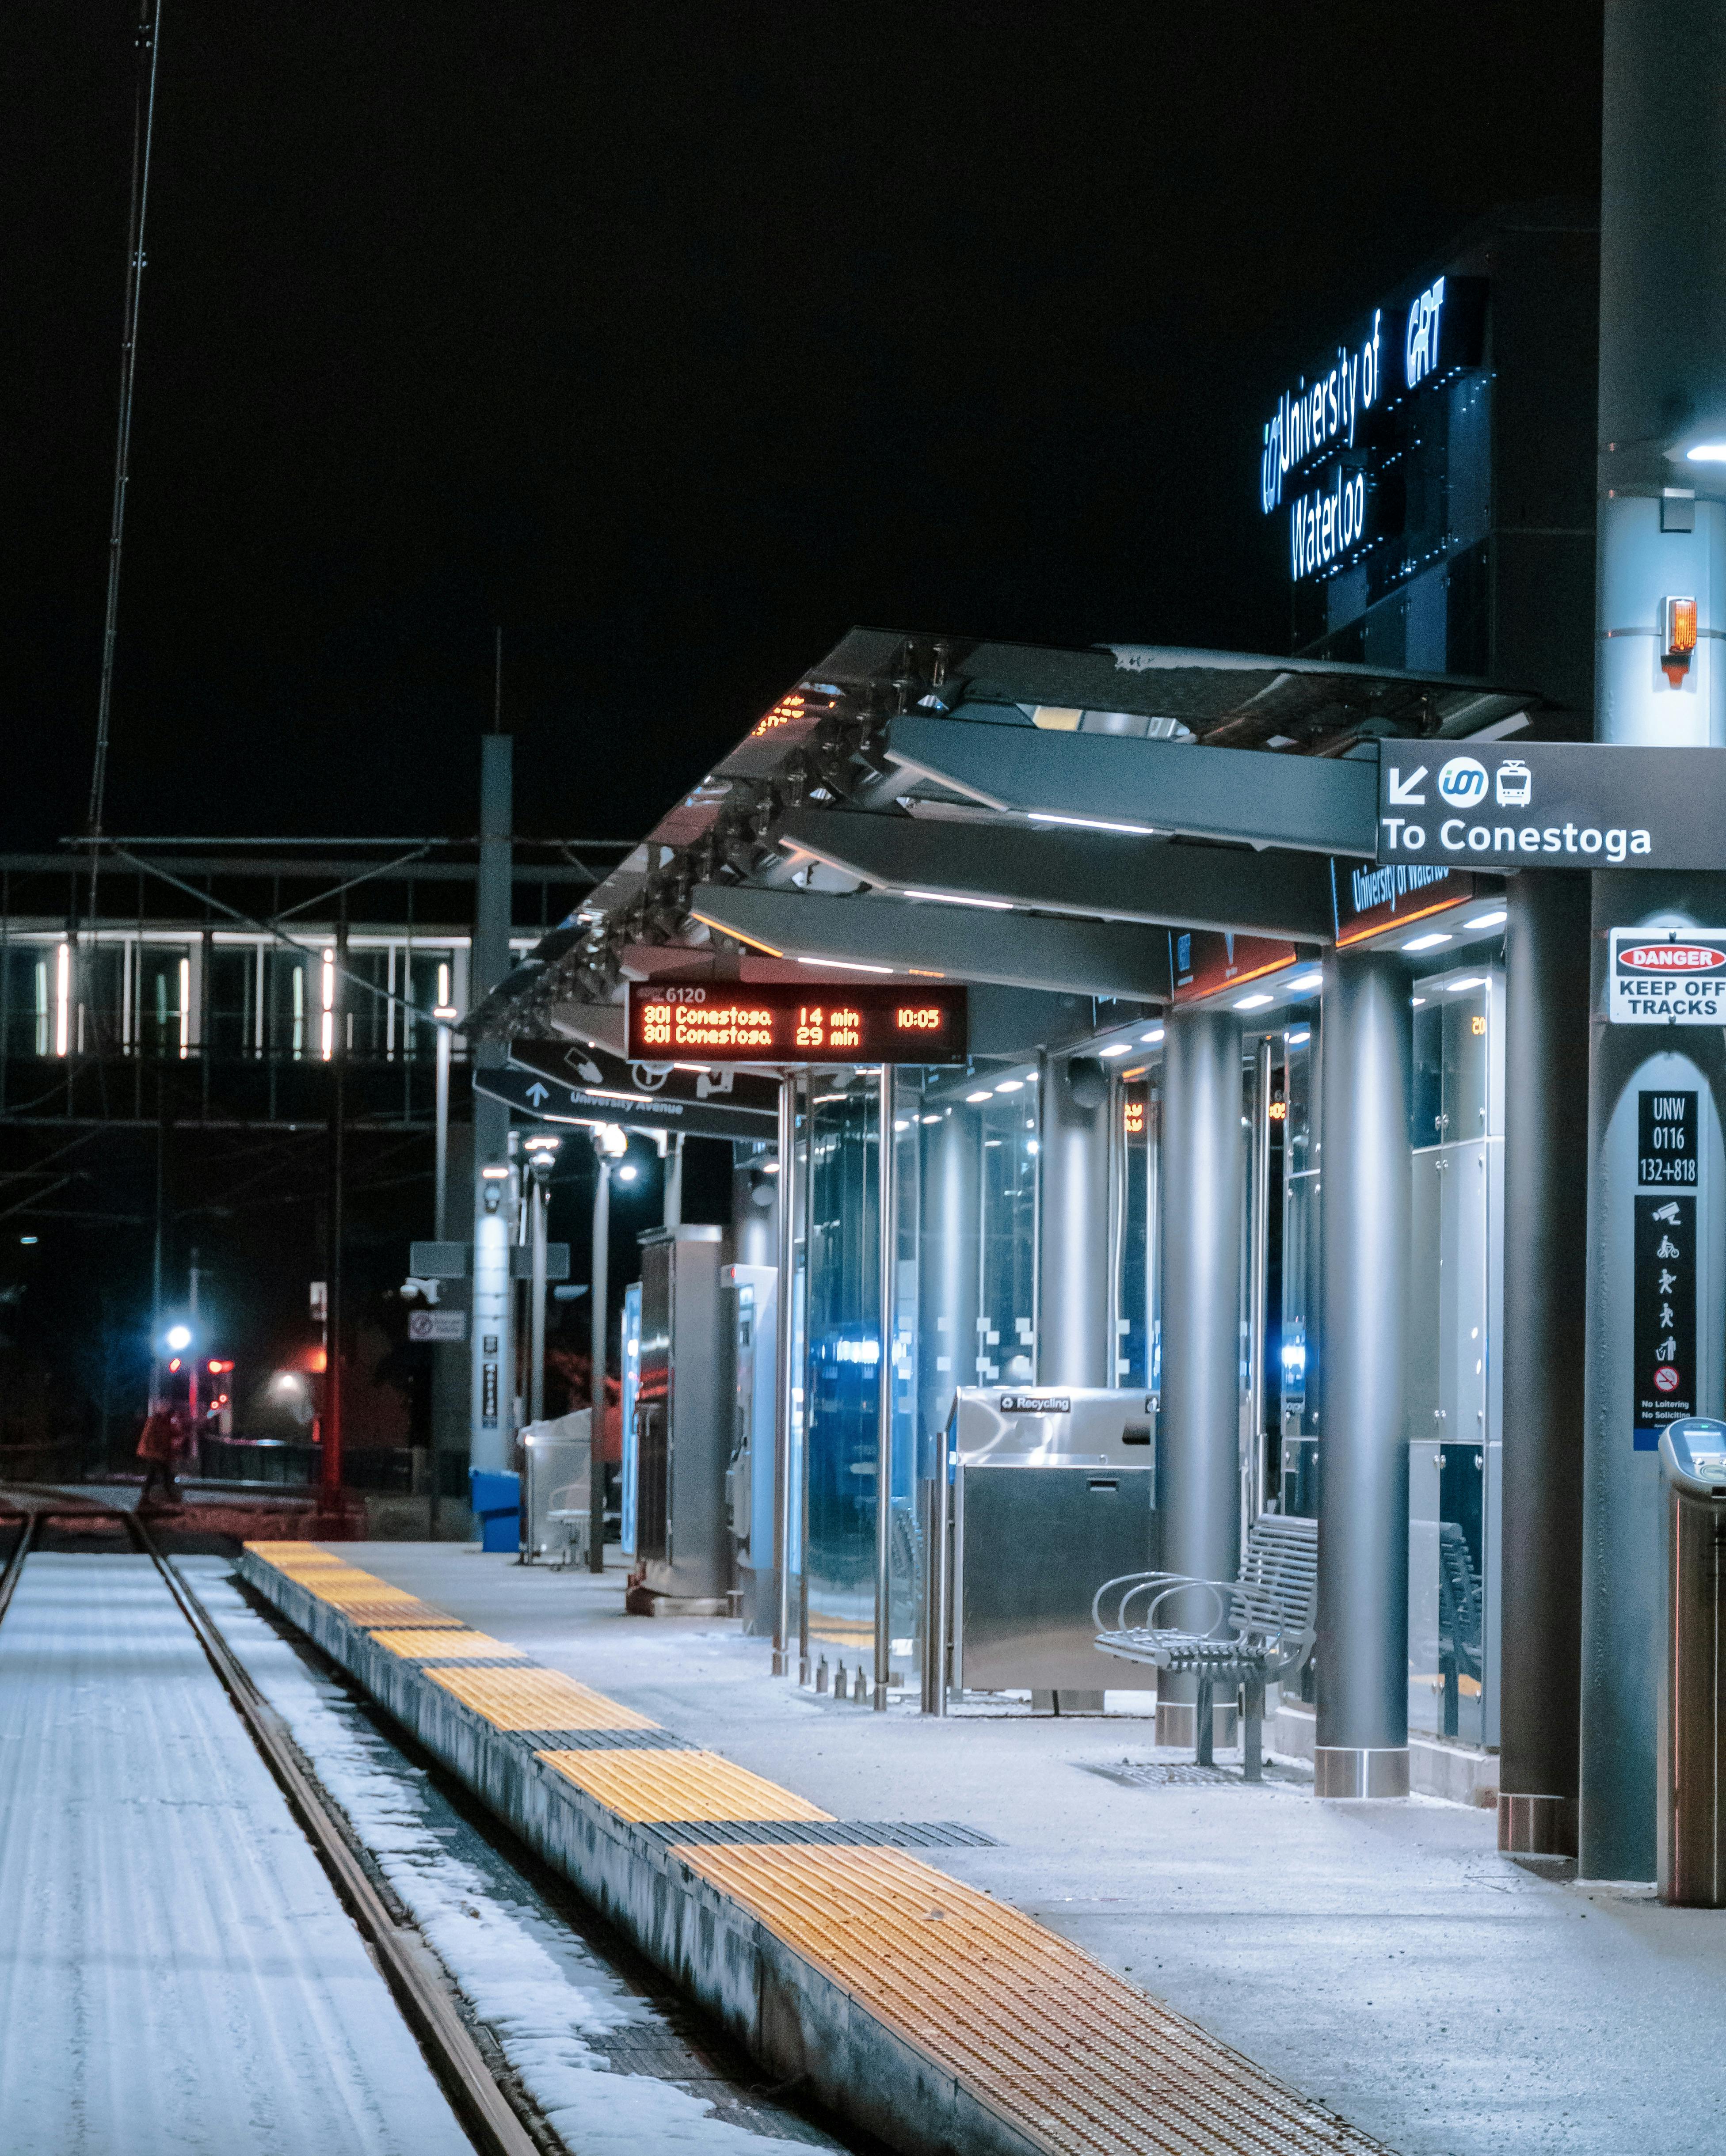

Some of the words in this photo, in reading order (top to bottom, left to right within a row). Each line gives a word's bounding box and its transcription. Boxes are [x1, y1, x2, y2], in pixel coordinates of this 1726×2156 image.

[1405, 275, 1445, 389] GRT
[1280, 346, 1358, 472] University
[1363, 309, 1381, 408] of
[1292, 465, 1364, 582] Waterloo
[1382, 818, 1425, 849] To
[1440, 819, 1651, 862] Conestoga
[1353, 865, 1395, 912] University
[1633, 951, 1713, 966] DANGER
[667, 987, 706, 1003] 6120
[1620, 981, 1677, 996] KEEP
[1685, 981, 1726, 996] OFF
[644, 1006, 670, 1023] 301
[676, 1006, 772, 1025] Conestoga
[801, 1008, 823, 1026] 14
[831, 1009, 859, 1027] min
[898, 1009, 939, 1027] 10:05
[1628, 1000, 1717, 1015] TRACKS
[644, 1025, 670, 1043] 301
[676, 1026, 772, 1045] Conestoga
[796, 1027, 823, 1046] 29
[831, 1027, 859, 1046] min
[570, 1091, 634, 1111] University
[636, 1102, 683, 1114] Avenue
[1654, 1097, 1685, 1120] UNW
[1654, 1127, 1684, 1149] 0116
[1640, 1159, 1696, 1181] 132+818
[1017, 1397, 1069, 1411] Recycling
[1655, 1400, 1689, 1410] Loitering
